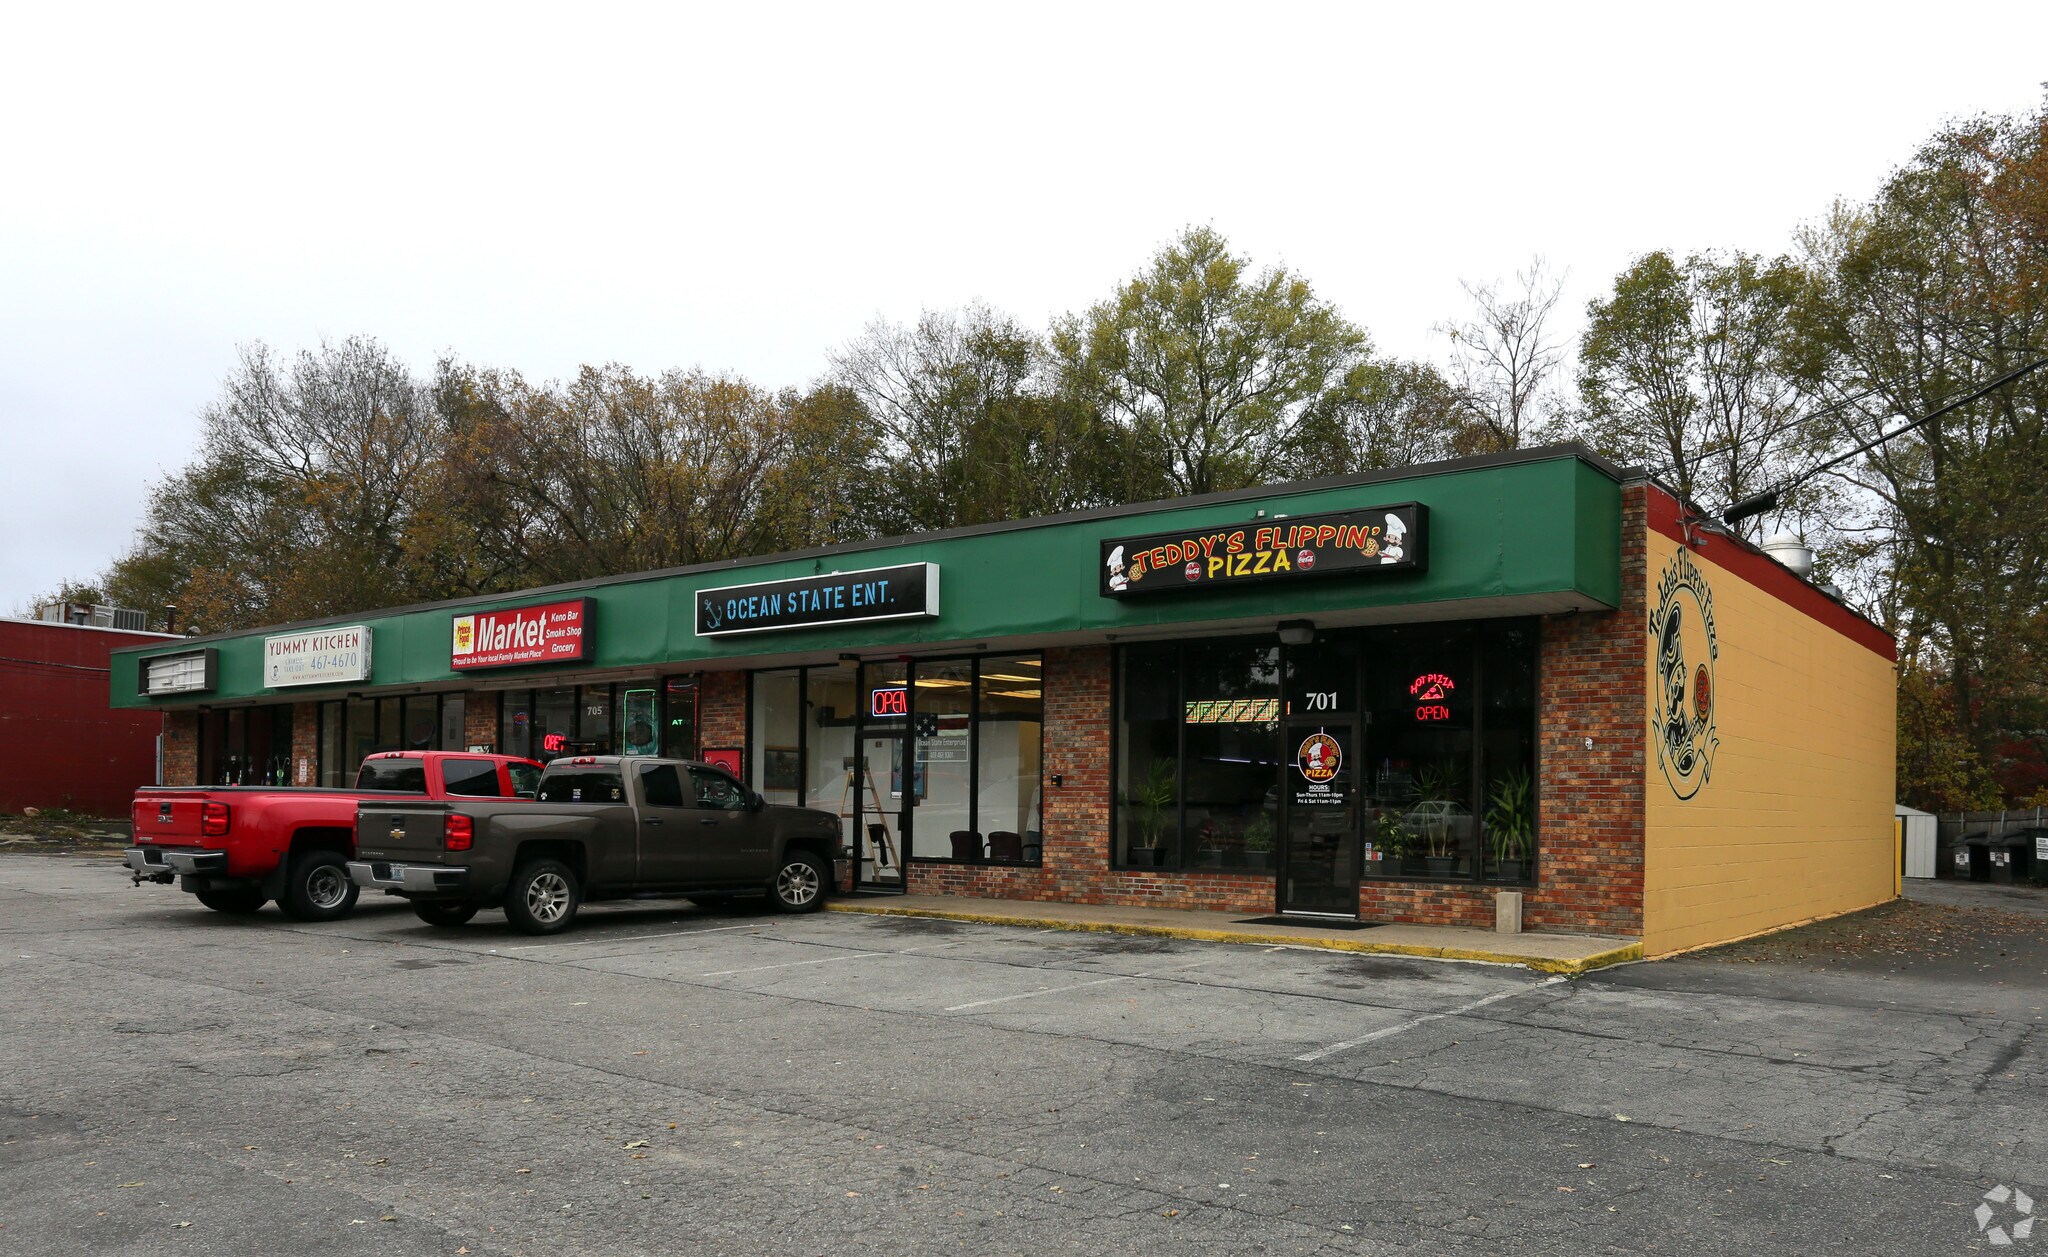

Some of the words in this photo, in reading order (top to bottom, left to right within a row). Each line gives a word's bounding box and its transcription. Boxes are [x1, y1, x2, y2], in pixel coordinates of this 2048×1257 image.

[1133, 530, 1245, 574] TEDDY'S
[1255, 524, 1381, 551] FLIPPIN'
[1208, 549, 1291, 579] PIZZA
[727, 594, 781, 620] OCEAN
[788, 586, 845, 613] STATE
[852, 580, 895, 607] ENT.
[551, 612, 566, 622] Keno
[567, 610, 579, 620] Bar
[1703, 586, 1719, 662] Pizza
[477, 611, 547, 652] Market
[546, 628, 566, 639] Smoke
[566, 626, 582, 636] Shop
[269, 639, 308, 656] YUMMY
[312, 633, 359, 651] KITCHEN
[551, 643, 576, 653] Grocery
[310, 652, 357, 670] 467-4670
[499, 652, 513, 662] Family
[513, 651, 529, 659] Market
[1410, 675, 1427, 694] HOT
[1427, 674, 1455, 689] PIZZA
[874, 691, 907, 714] OPEN
[1306, 692, 1337, 710] 701
[587, 706, 603, 716] 705
[1416, 706, 1449, 720] OPEN
[1305, 769, 1333, 777] PIZZA
